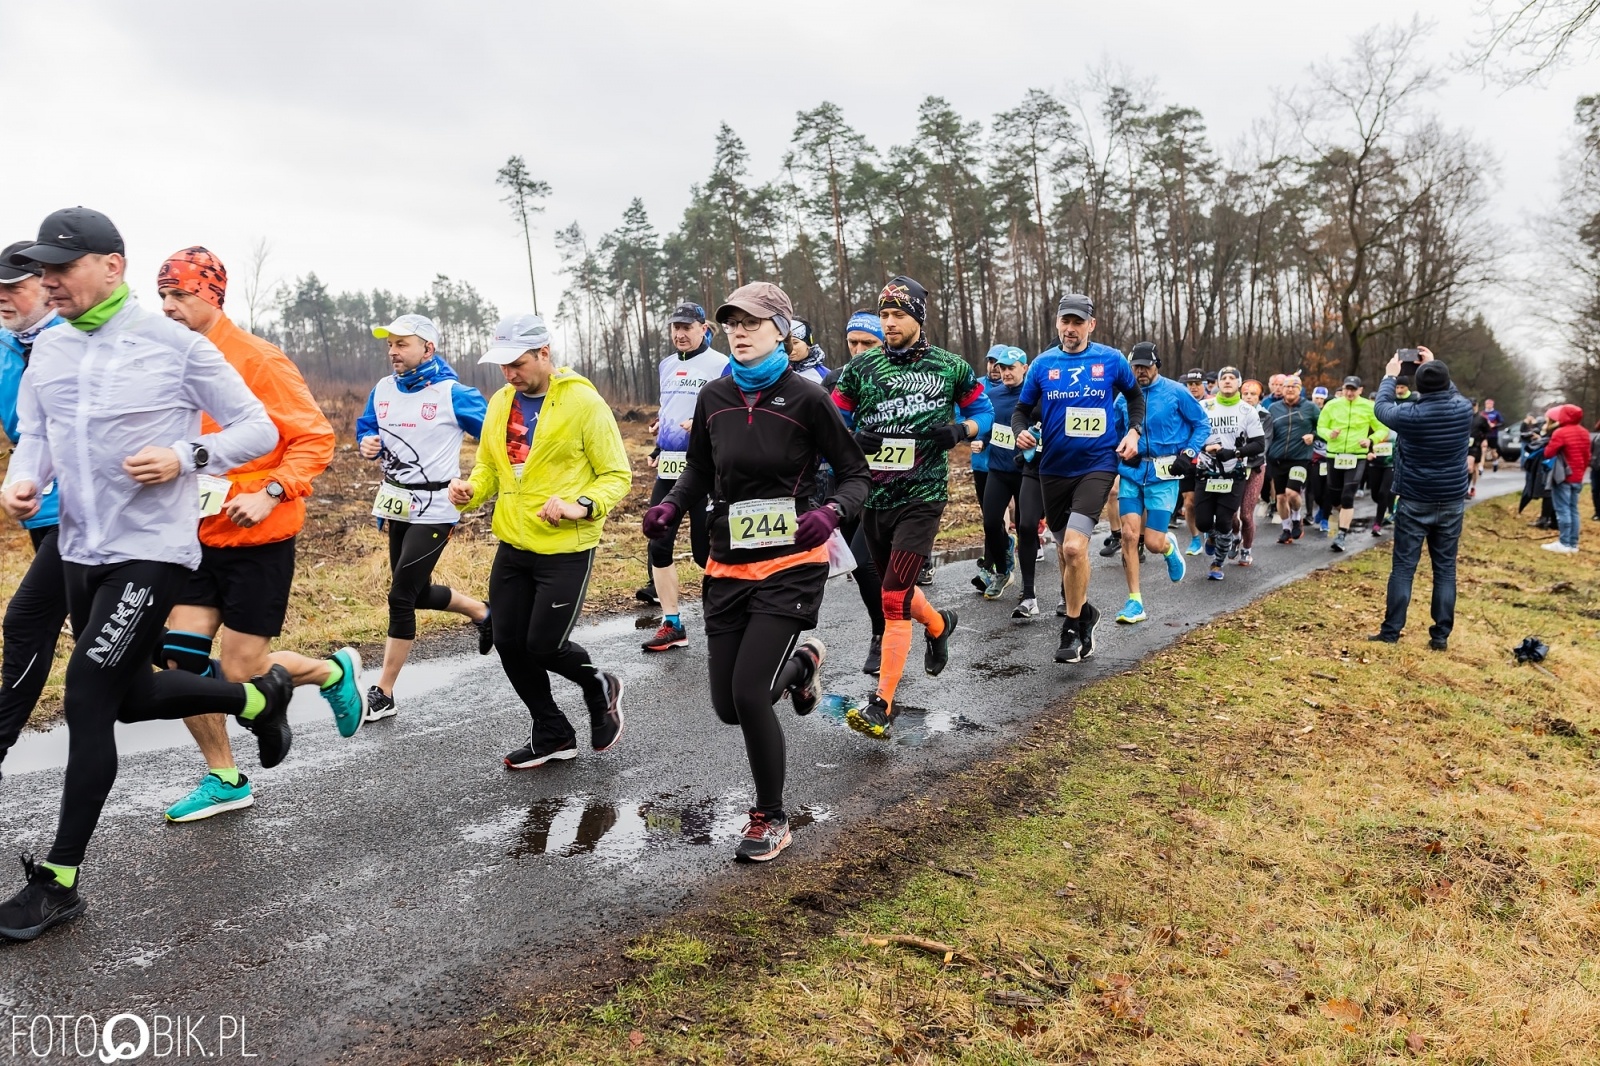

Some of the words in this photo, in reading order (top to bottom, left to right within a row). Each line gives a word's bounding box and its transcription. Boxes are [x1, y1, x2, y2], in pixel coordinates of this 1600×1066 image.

[1047, 390, 1080, 400] HRmax
[1083, 385, 1106, 399] Żory
[877, 397, 905, 412] BIEG
[906, 393, 925, 406] PO
[1072, 418, 1101, 431] 212
[994, 431, 1011, 444] 231
[873, 446, 907, 464] 227
[662, 461, 686, 474] 205
[1211, 483, 1229, 491] 159
[377, 495, 403, 515] 249
[740, 513, 788, 539] 244
[85, 581, 147, 664] NIKE
